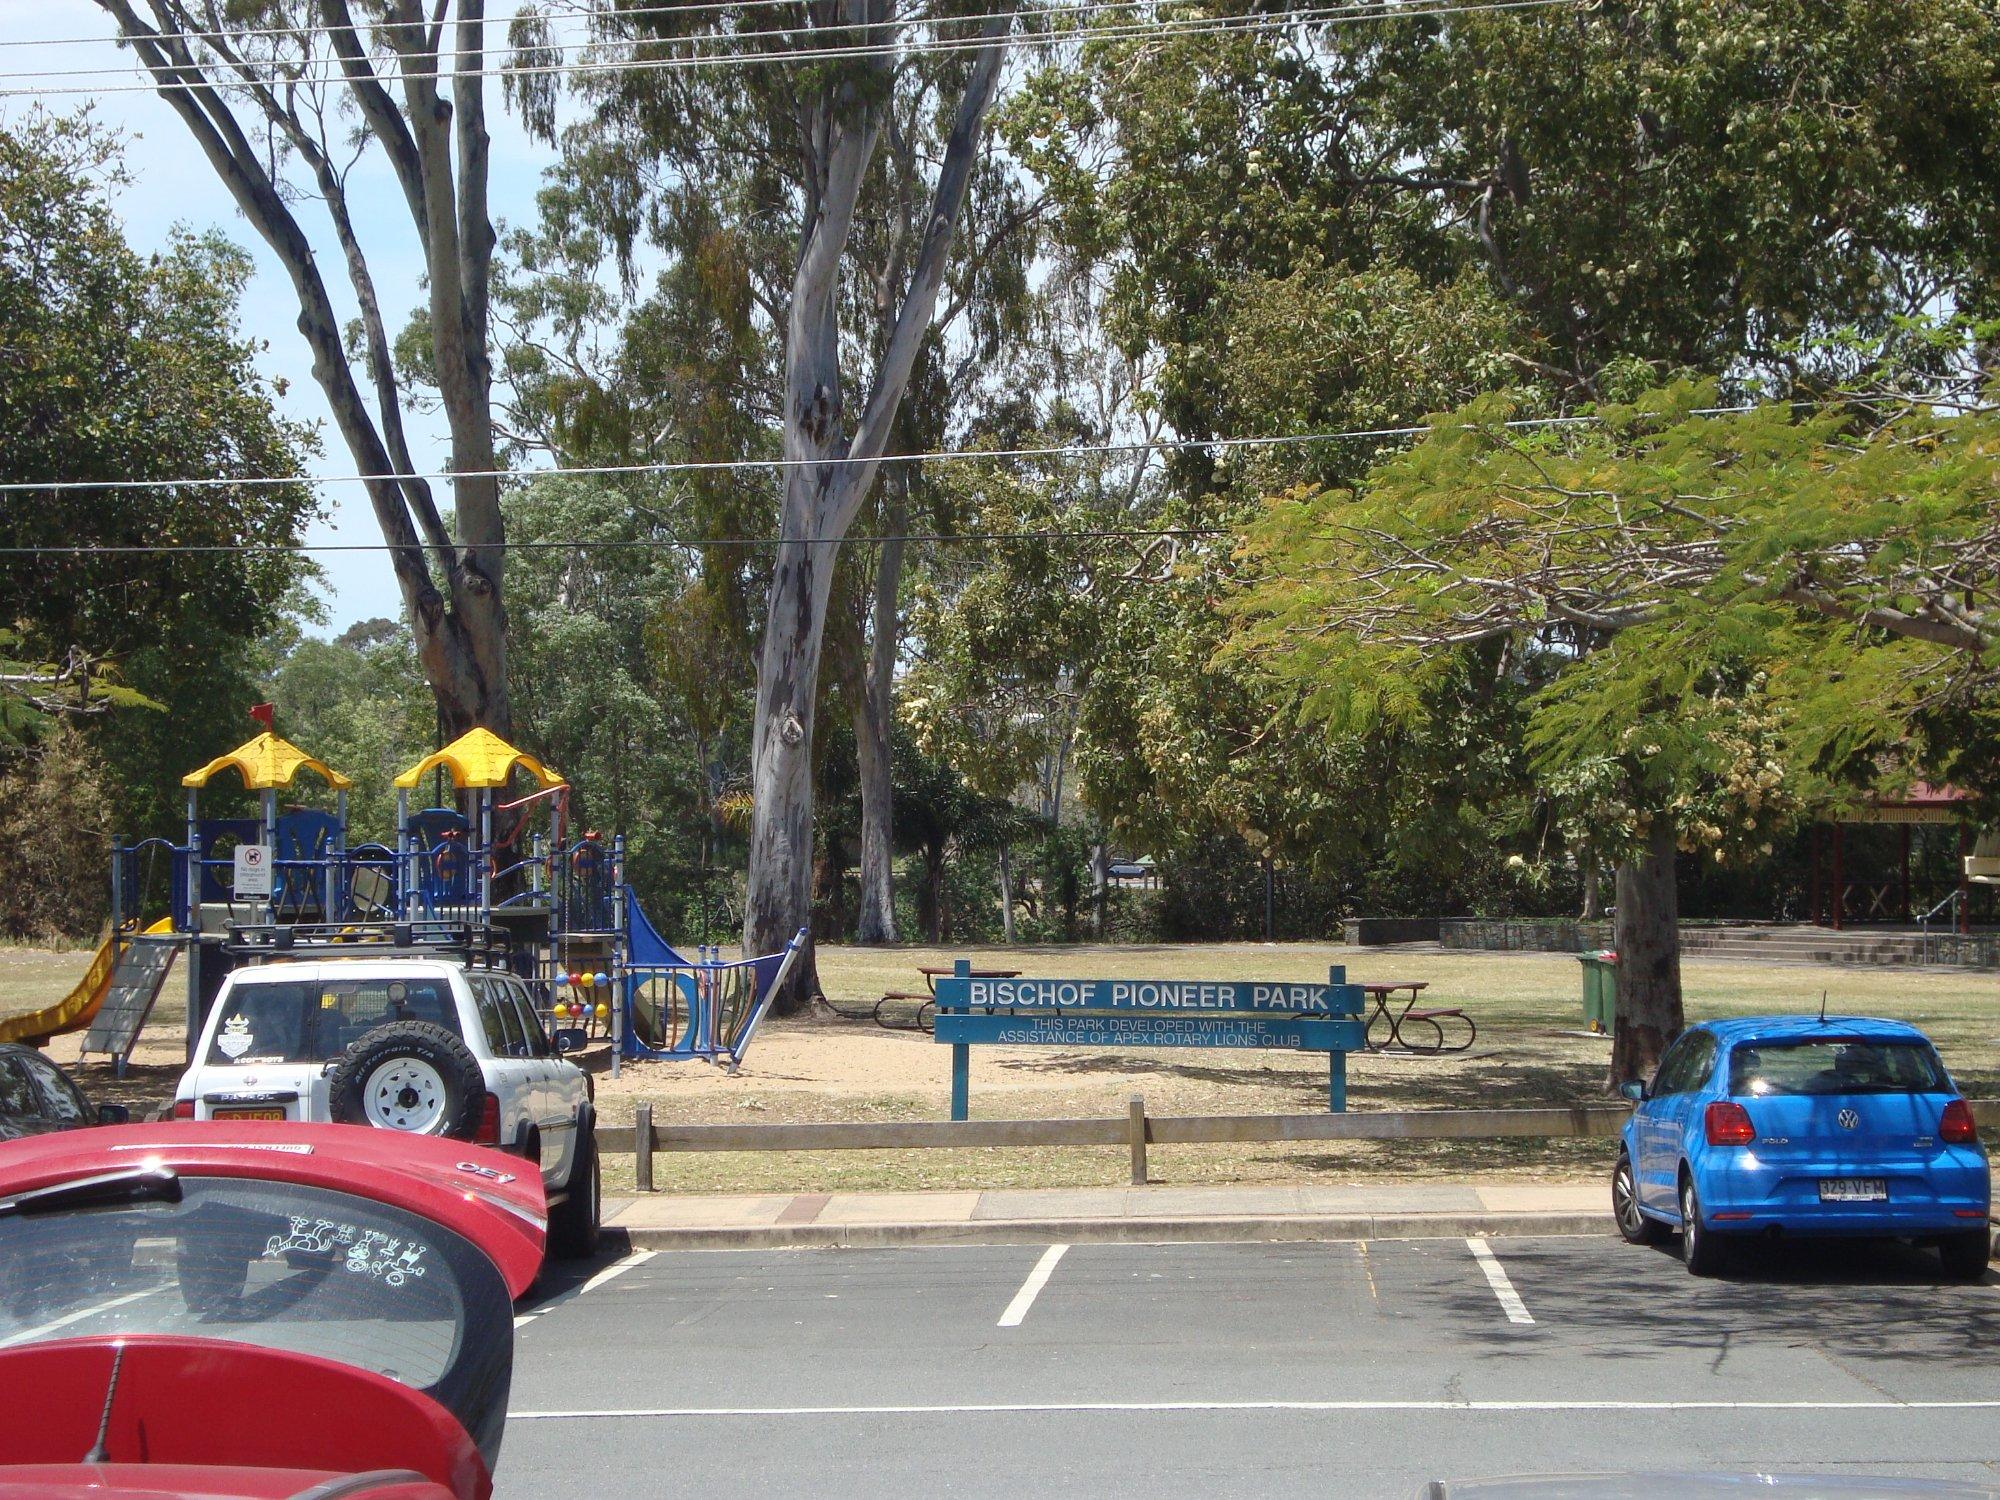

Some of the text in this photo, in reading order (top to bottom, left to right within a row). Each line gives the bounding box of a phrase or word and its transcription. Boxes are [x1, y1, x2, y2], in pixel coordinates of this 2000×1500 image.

[970, 982, 1329, 1010] BISCHOF PIONEER PARK
[1032, 1018, 1267, 1034] THIS PARK DEVELOPED WITH THE
[998, 1030, 1301, 1047] ASSISTANCE OF APEX ROTARY LIONS CLUB
